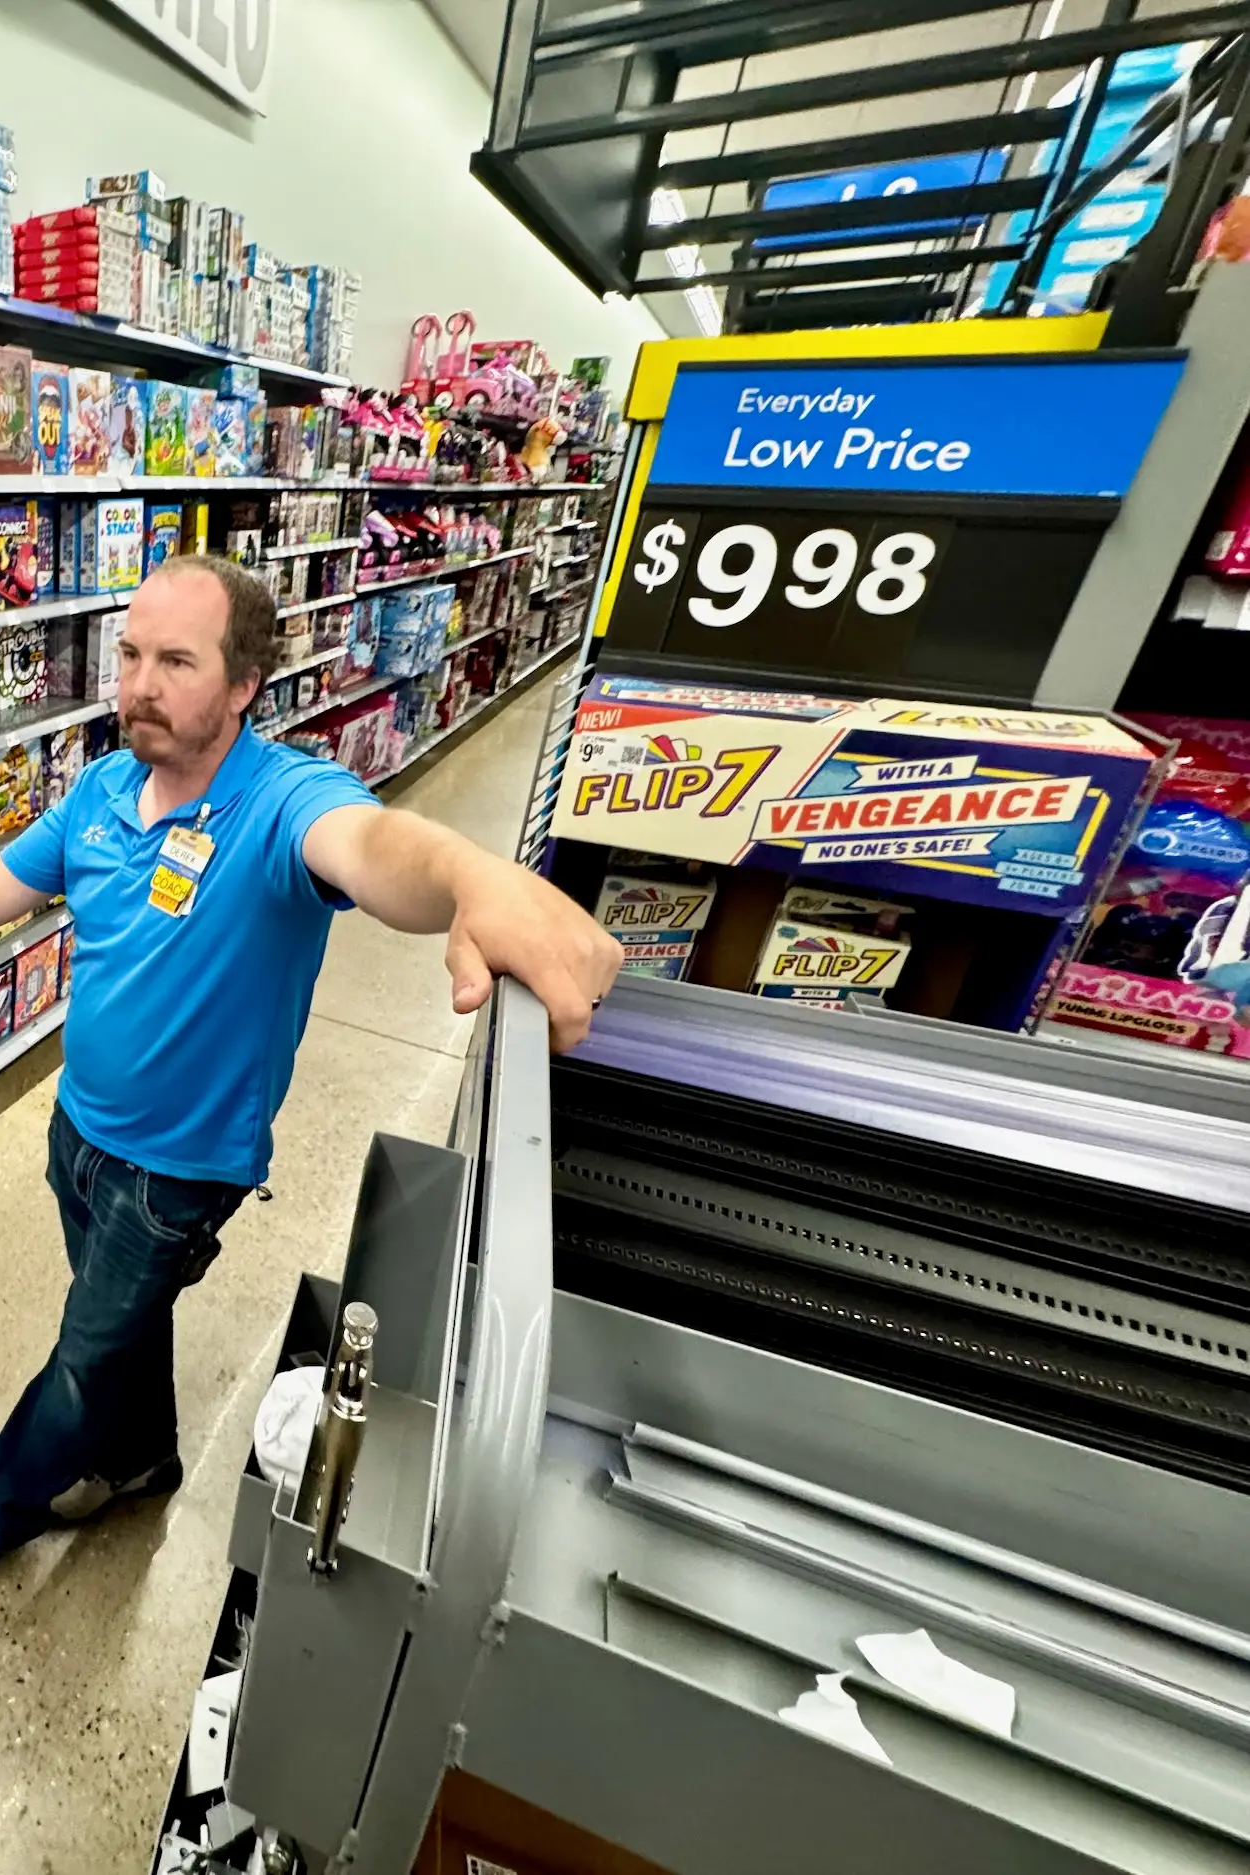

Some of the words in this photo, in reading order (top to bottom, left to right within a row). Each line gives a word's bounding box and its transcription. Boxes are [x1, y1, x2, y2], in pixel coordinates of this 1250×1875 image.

[737, 386, 876, 420] Everyday
[37, 422, 61, 446] OUT
[724, 428, 821, 469] Low
[834, 427, 971, 472] Price
[105, 522, 136, 537] STACK
[1, 628, 47, 655] TROUBLE
[579, 708, 622, 730] NEW!
[877, 763, 936, 780] WITH
[939, 762, 953, 776] A
[769, 784, 1070, 833] VENGEANCE
[818, 842, 848, 859] NO
[850, 841, 911, 858] ONE'S
[913, 838, 973, 854] SAFE!
[1021, 851, 1051, 863] AGES
[1020, 866, 1077, 883] PLAYERS
[153, 875, 188, 898] COACH
[624, 944, 688, 957] GEANCE
[772, 954, 860, 977] FLIP
[851, 948, 901, 985] 7
[1109, 1012, 1187, 1035] LIPGLOSS
